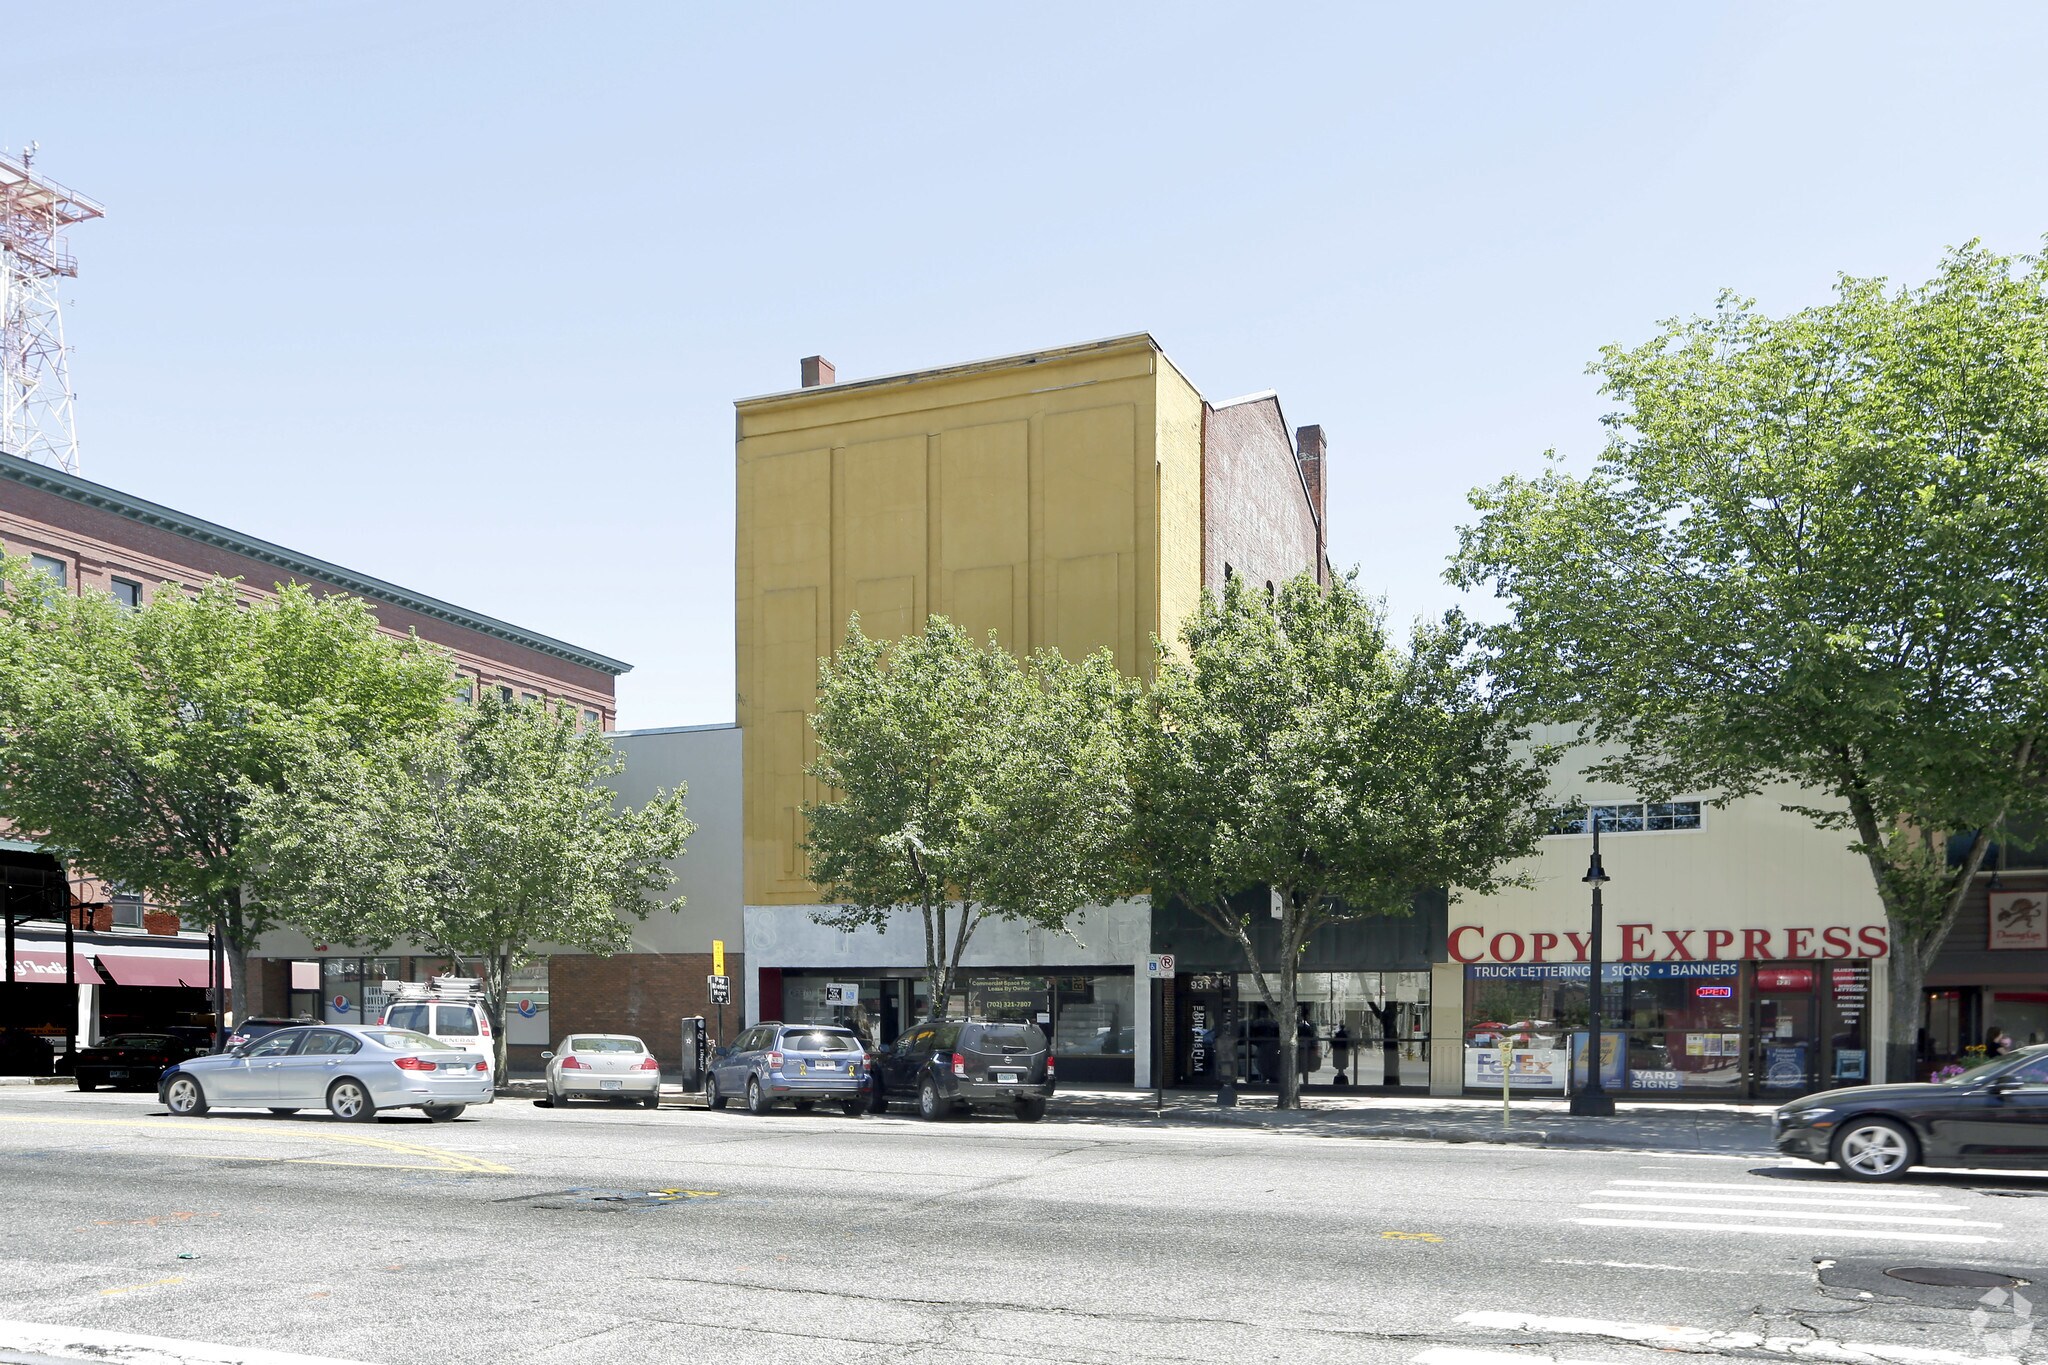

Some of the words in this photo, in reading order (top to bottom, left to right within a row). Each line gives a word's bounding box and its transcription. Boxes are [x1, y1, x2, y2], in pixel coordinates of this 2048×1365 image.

[1447, 925, 1593, 964] COPY
[1616, 923, 1889, 963] EXPRESS
[1474, 966, 1516, 977] TRUCK
[1520, 965, 1592, 977] LETTERING
[1611, 964, 1650, 976] SIGNS
[1670, 963, 1737, 976] BANNERS
[1696, 988, 1728, 996] OPEN
[1477, 1053, 1553, 1075] FedEx
[1634, 1071, 1676, 1080] YARD
[1632, 1080, 1679, 1089] SIGNS
